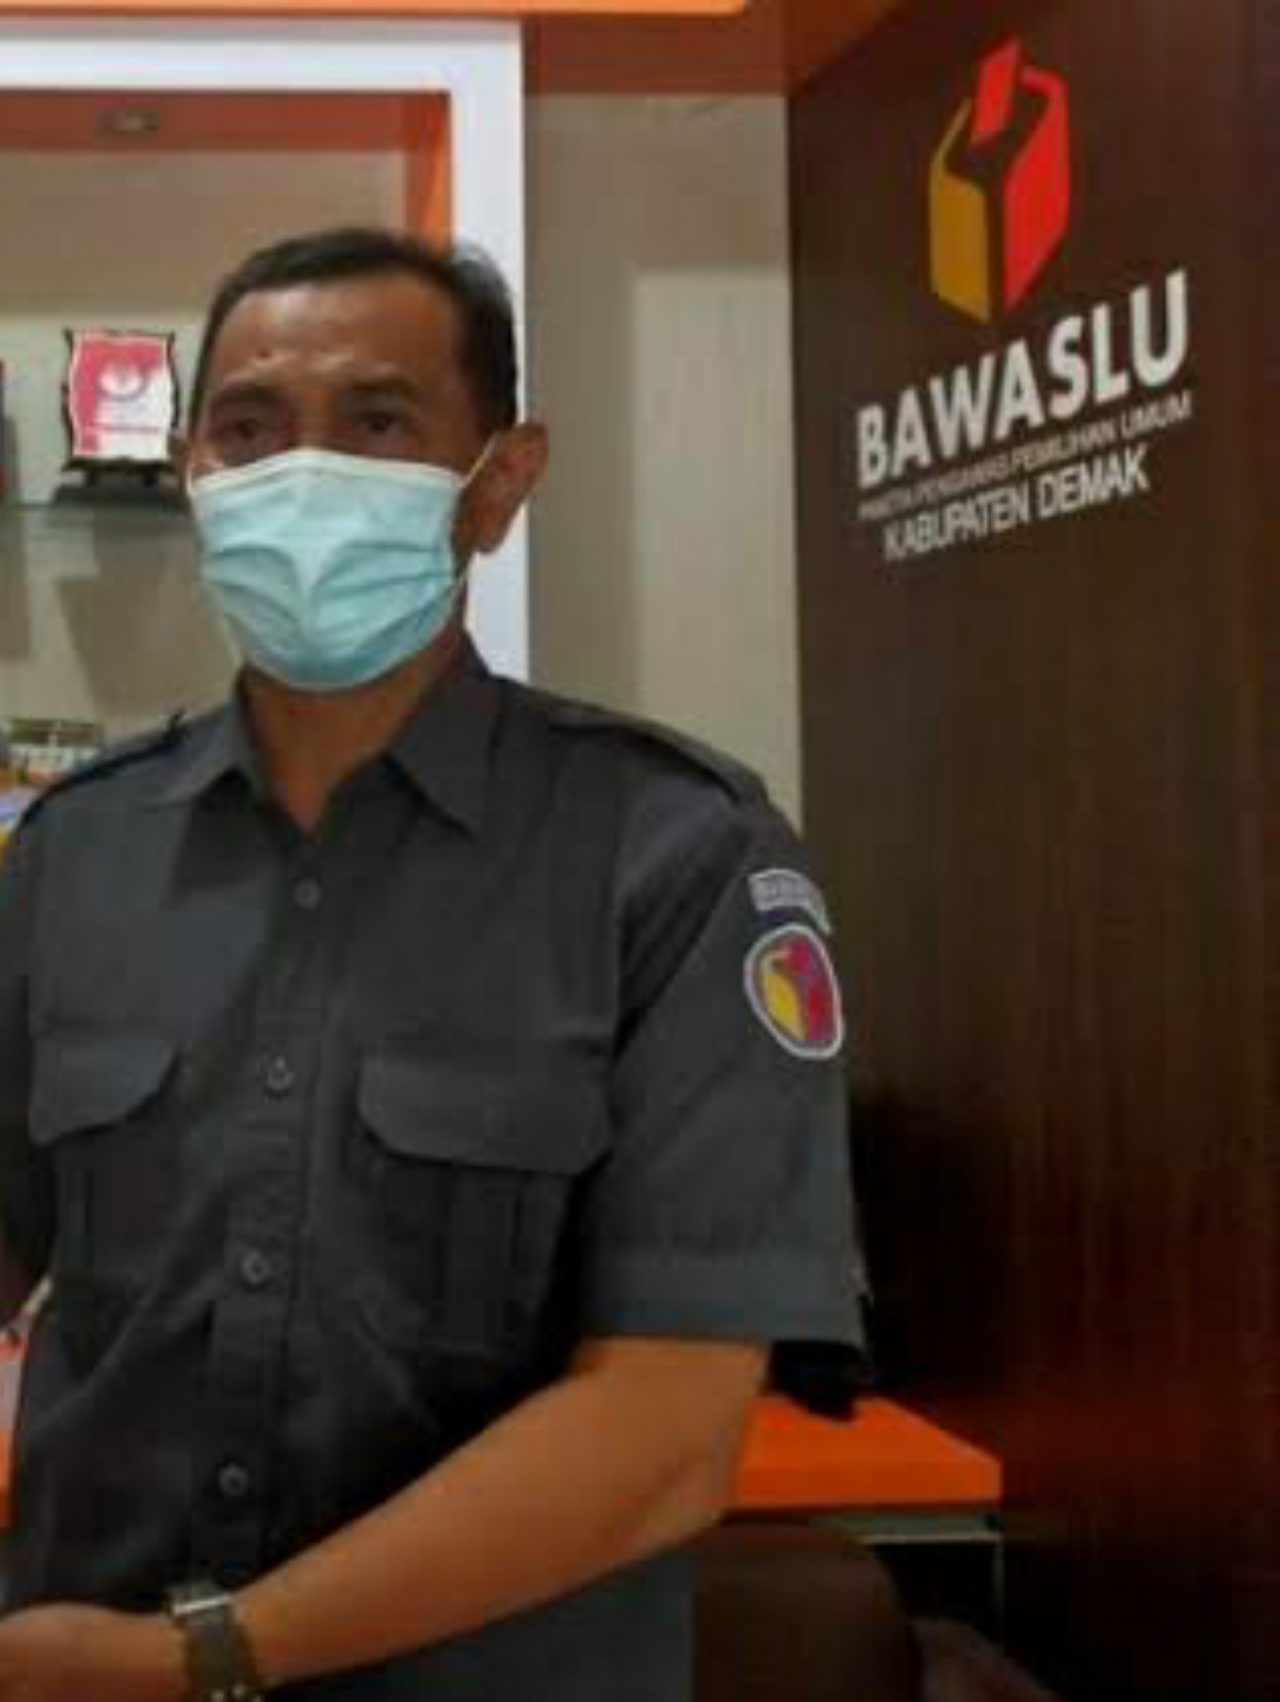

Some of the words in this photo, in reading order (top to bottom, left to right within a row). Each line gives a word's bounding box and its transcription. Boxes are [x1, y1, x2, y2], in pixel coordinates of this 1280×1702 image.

[858, 268, 1189, 489] BAWASLU
[884, 482, 1031, 560] KABUPATEN
[1037, 444, 1150, 518] DEMAK
